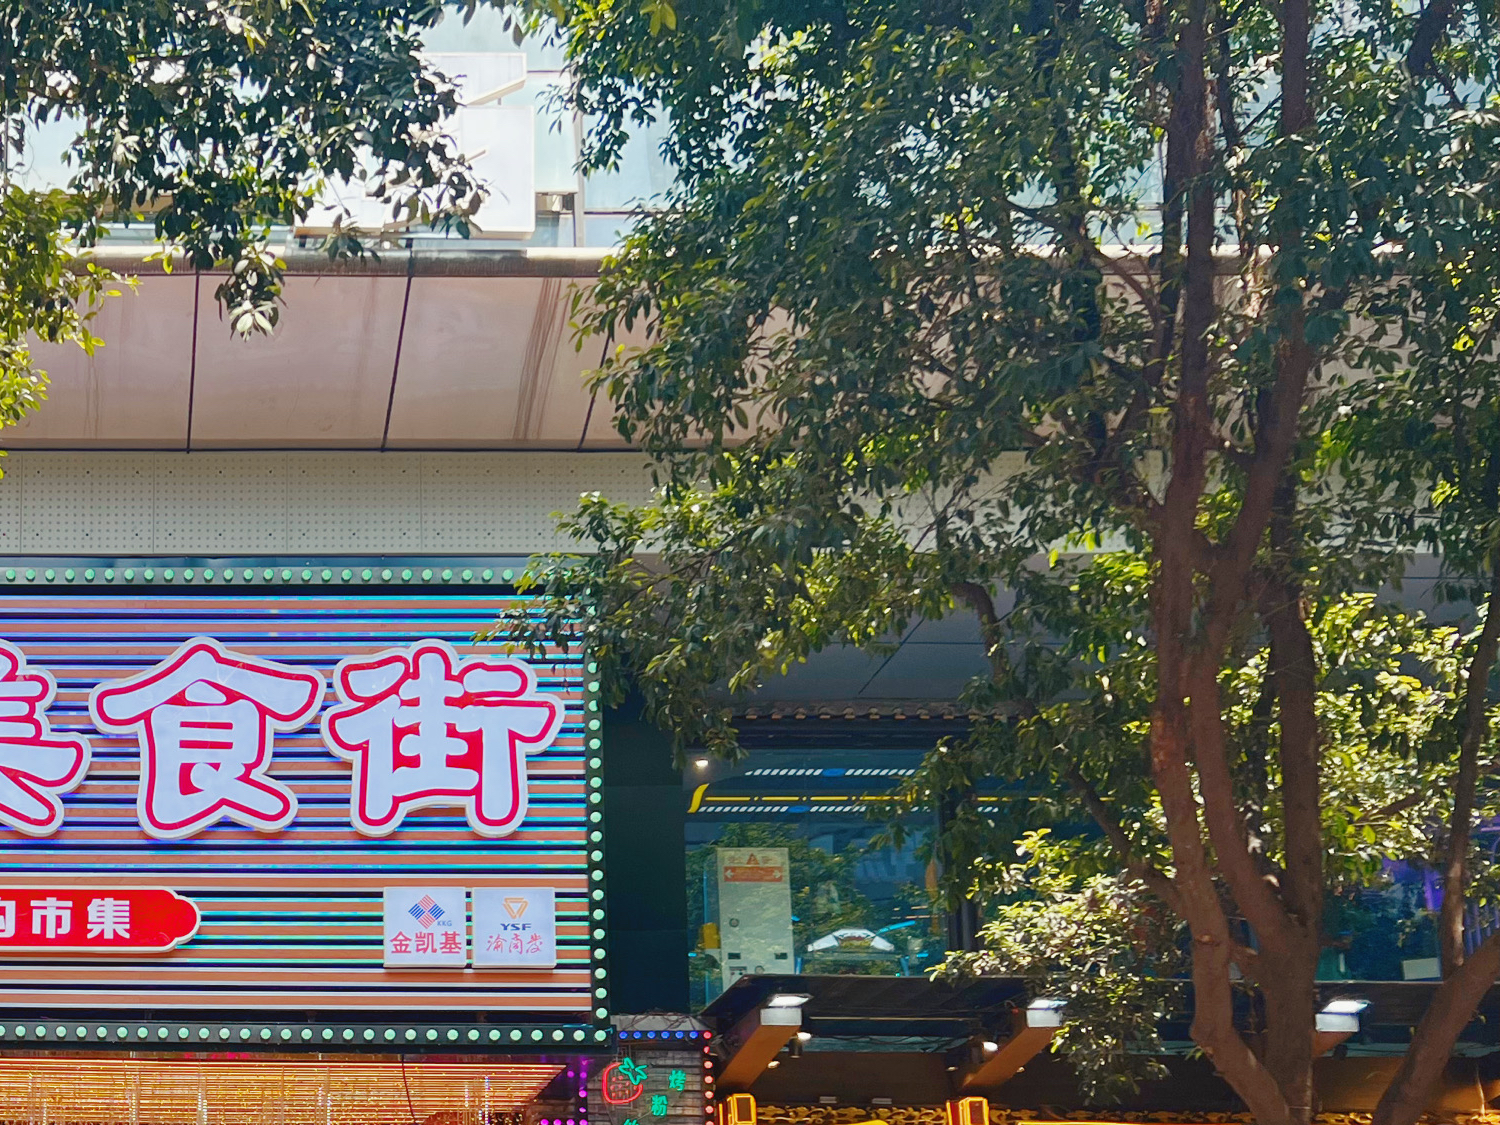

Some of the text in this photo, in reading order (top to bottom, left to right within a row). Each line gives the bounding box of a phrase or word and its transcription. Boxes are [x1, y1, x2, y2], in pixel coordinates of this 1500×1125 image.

[500, 922, 533, 931] YSF
[389, 931, 463, 955] 金凯基
